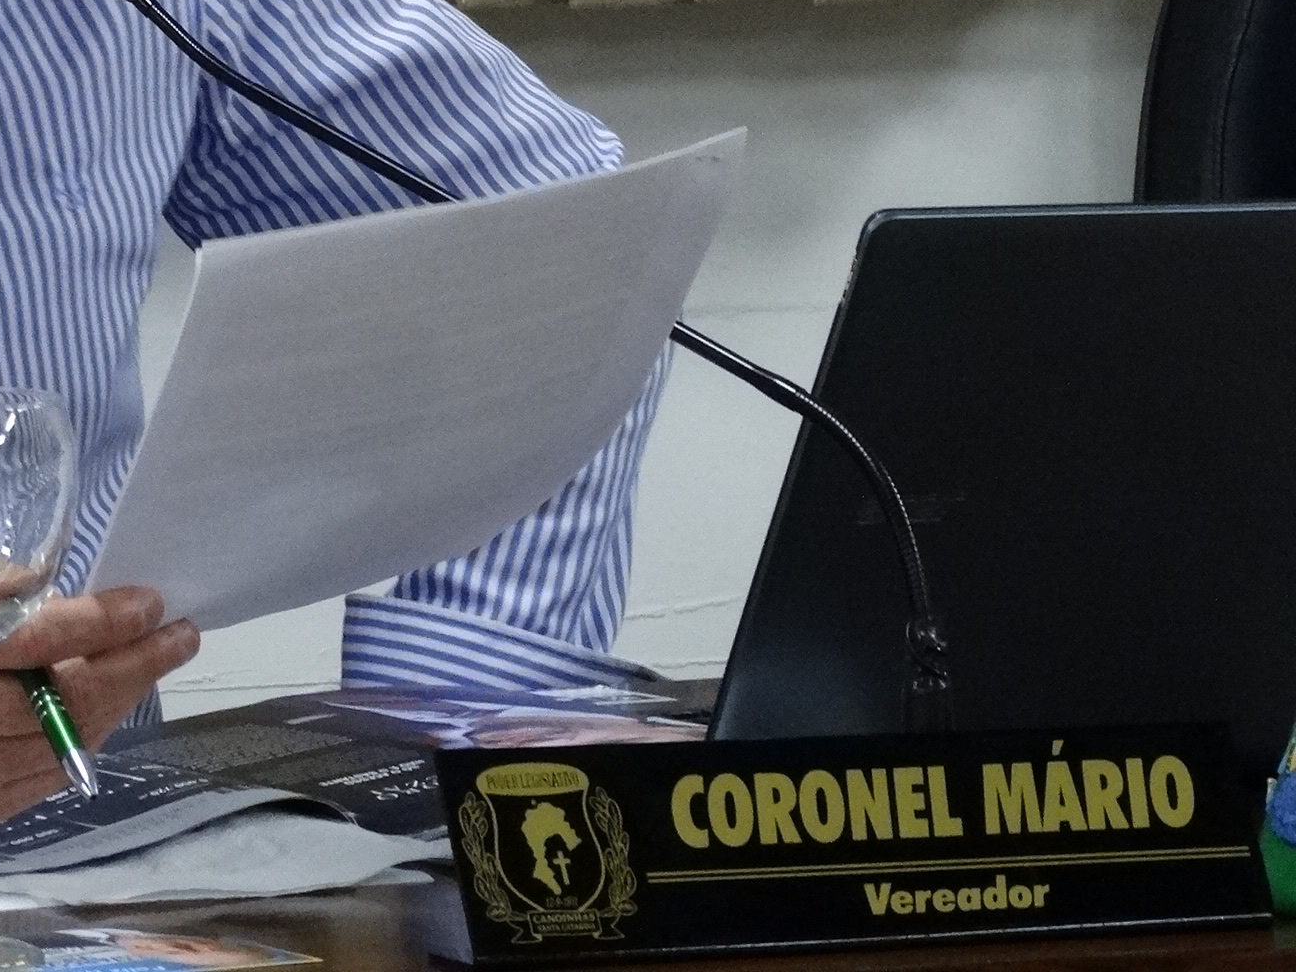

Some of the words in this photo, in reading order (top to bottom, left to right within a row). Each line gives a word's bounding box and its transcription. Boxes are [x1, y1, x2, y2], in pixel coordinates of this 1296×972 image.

[672, 766, 964, 848] CORONEL
[983, 739, 1195, 835] MÁRIO
[863, 874, 1052, 915] Vereador
